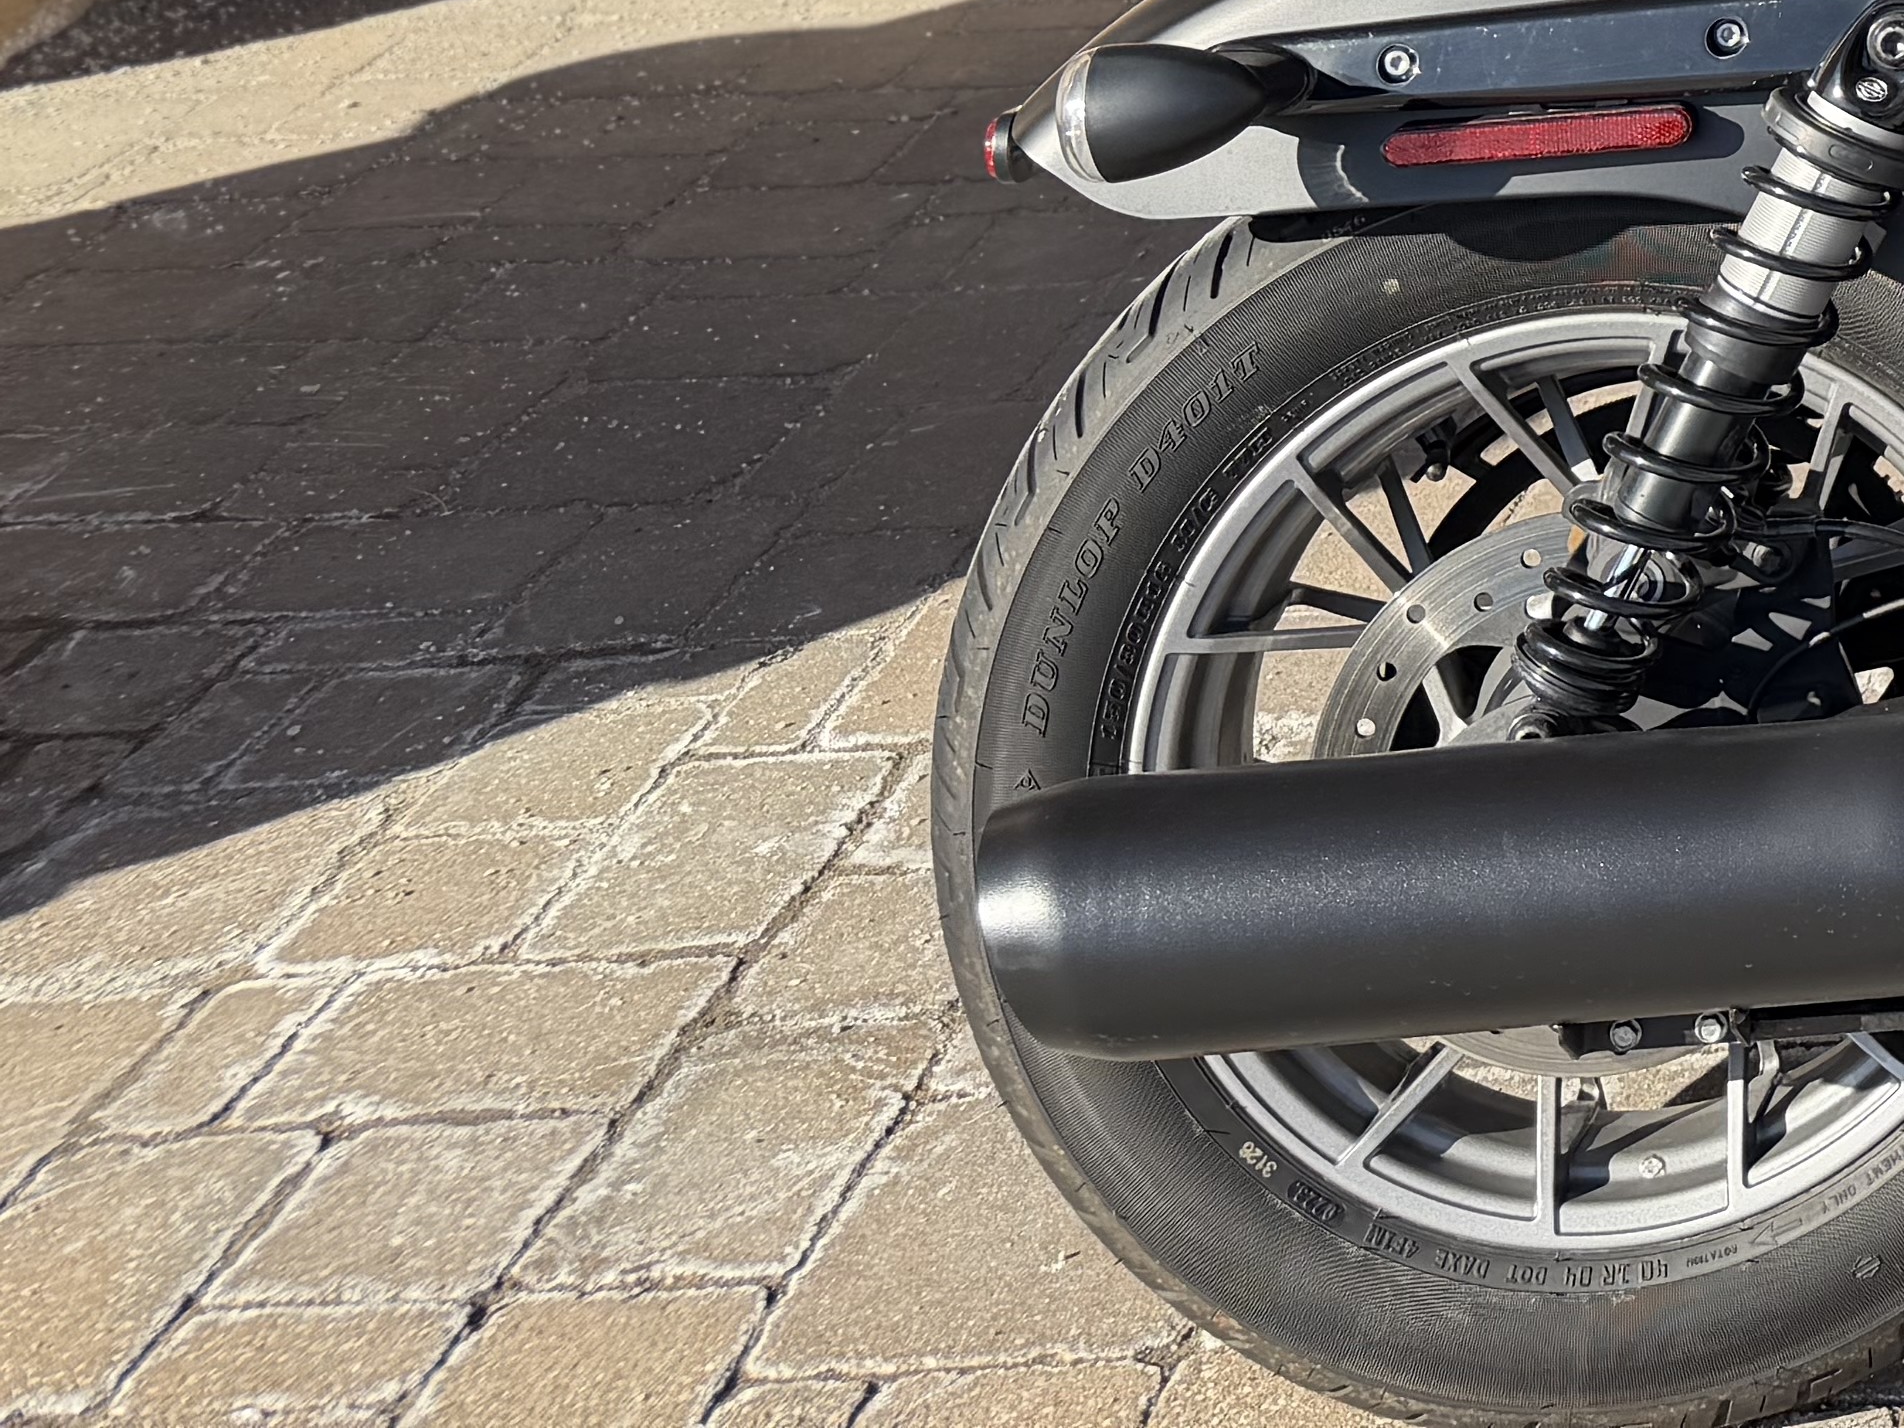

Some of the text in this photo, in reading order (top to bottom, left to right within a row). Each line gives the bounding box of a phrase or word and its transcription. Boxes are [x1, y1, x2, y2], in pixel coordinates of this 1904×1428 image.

[1022, 341, 1260, 738] DUNLOP D401T
[1822, 1181, 1858, 1215] ONLY
[1505, 1263, 1548, 1286] DOT
